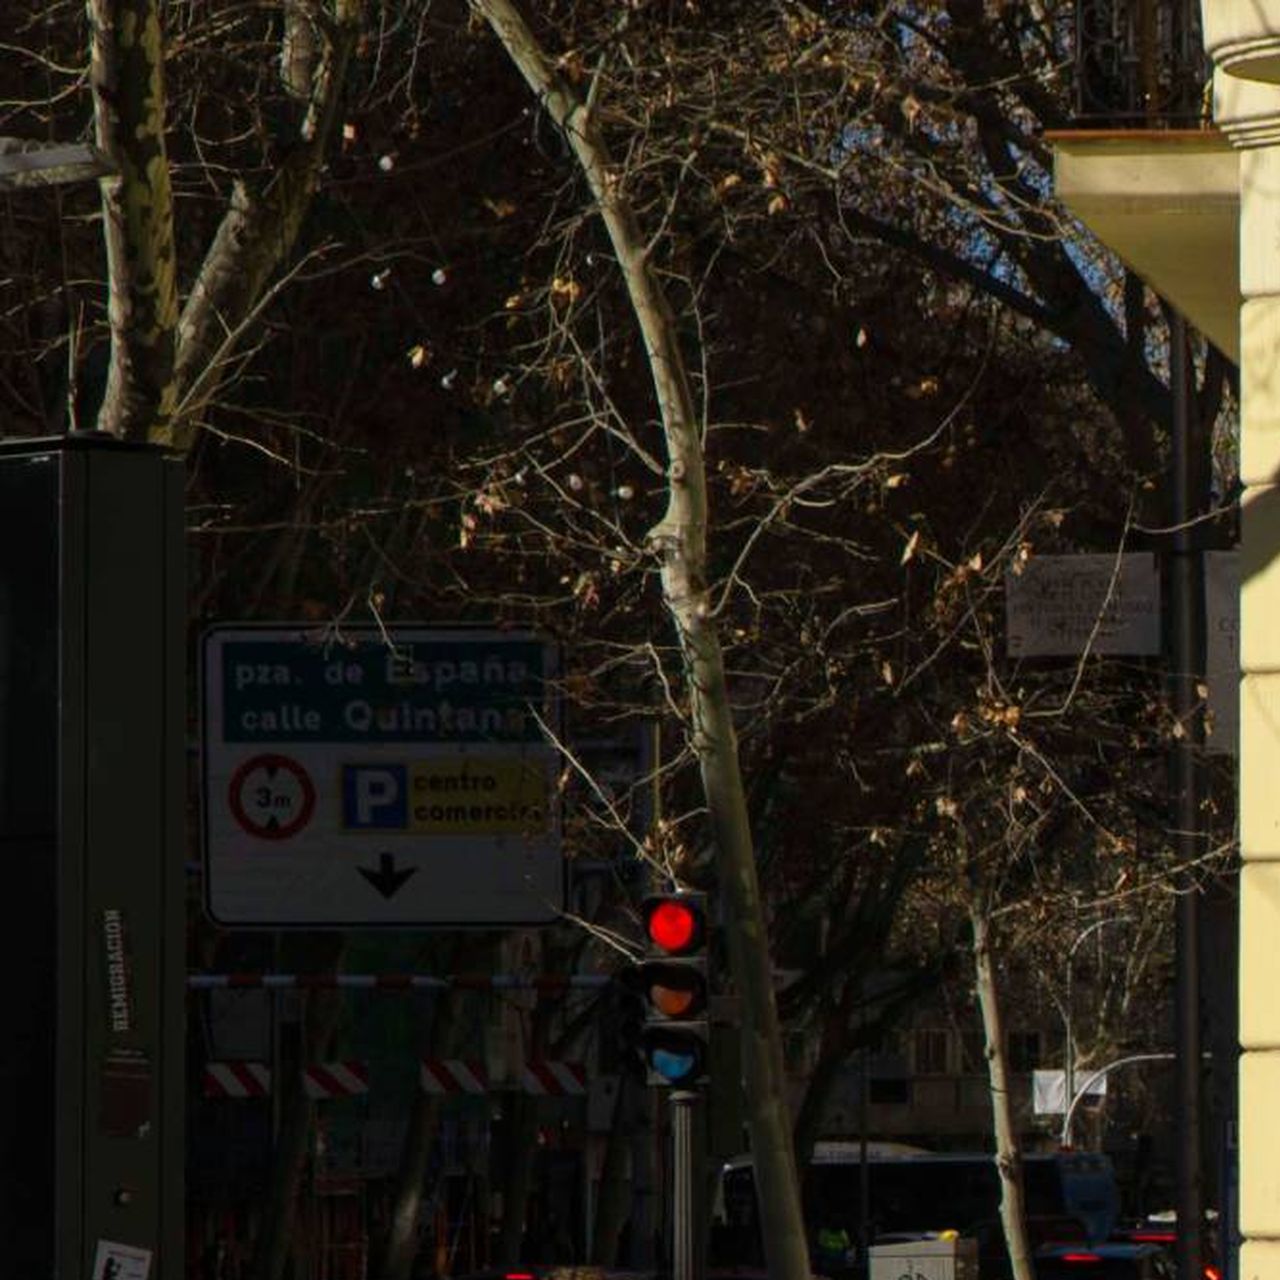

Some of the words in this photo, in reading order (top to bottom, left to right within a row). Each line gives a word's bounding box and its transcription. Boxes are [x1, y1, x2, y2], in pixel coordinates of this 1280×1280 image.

[324, 660, 364, 685] de
[385, 655, 527, 692] España
[240, 705, 322, 732] calle
[414, 773, 496, 791] centro
